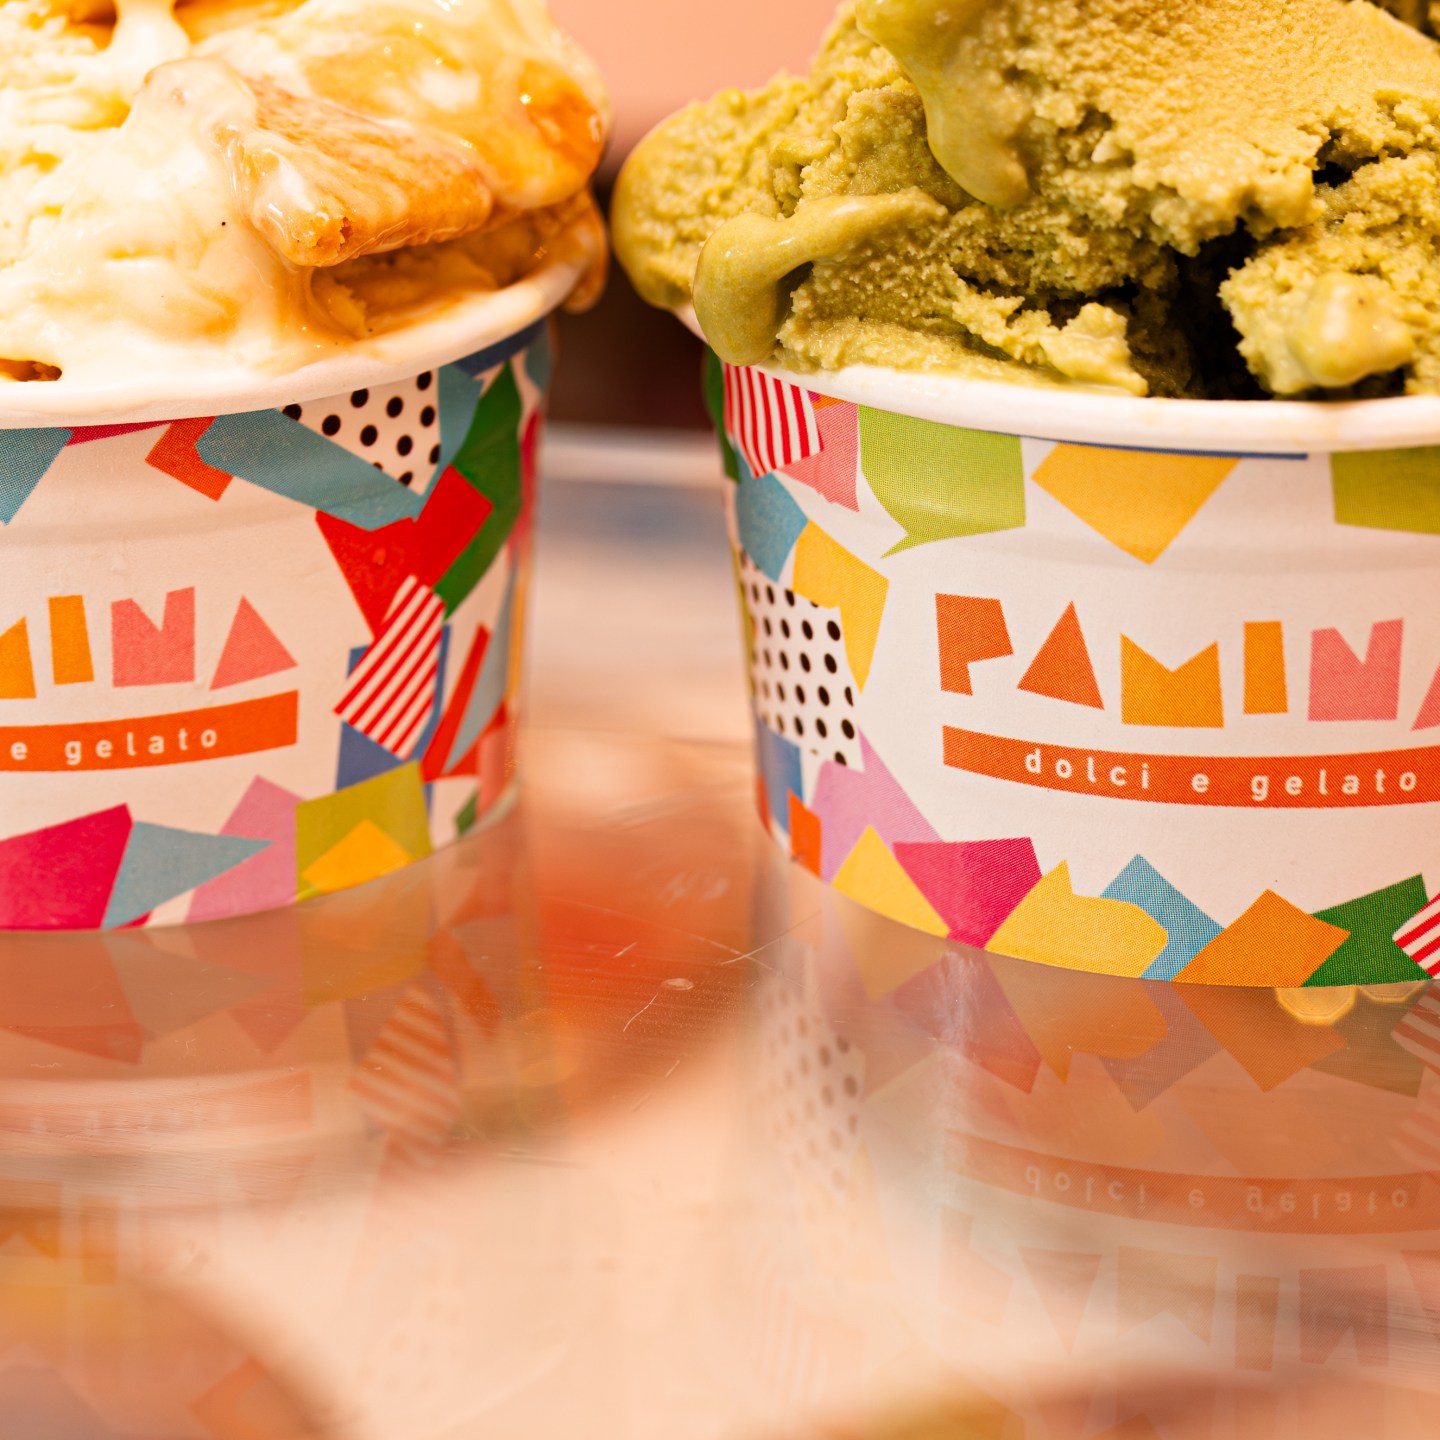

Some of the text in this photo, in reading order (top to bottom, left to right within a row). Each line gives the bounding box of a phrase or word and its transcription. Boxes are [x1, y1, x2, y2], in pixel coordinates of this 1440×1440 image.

[934, 592, 1440, 732] PAMIN
[10, 740, 28, 761] e
[64, 727, 219, 766] gelato
[1024, 747, 1419, 802] dolci e gelato
